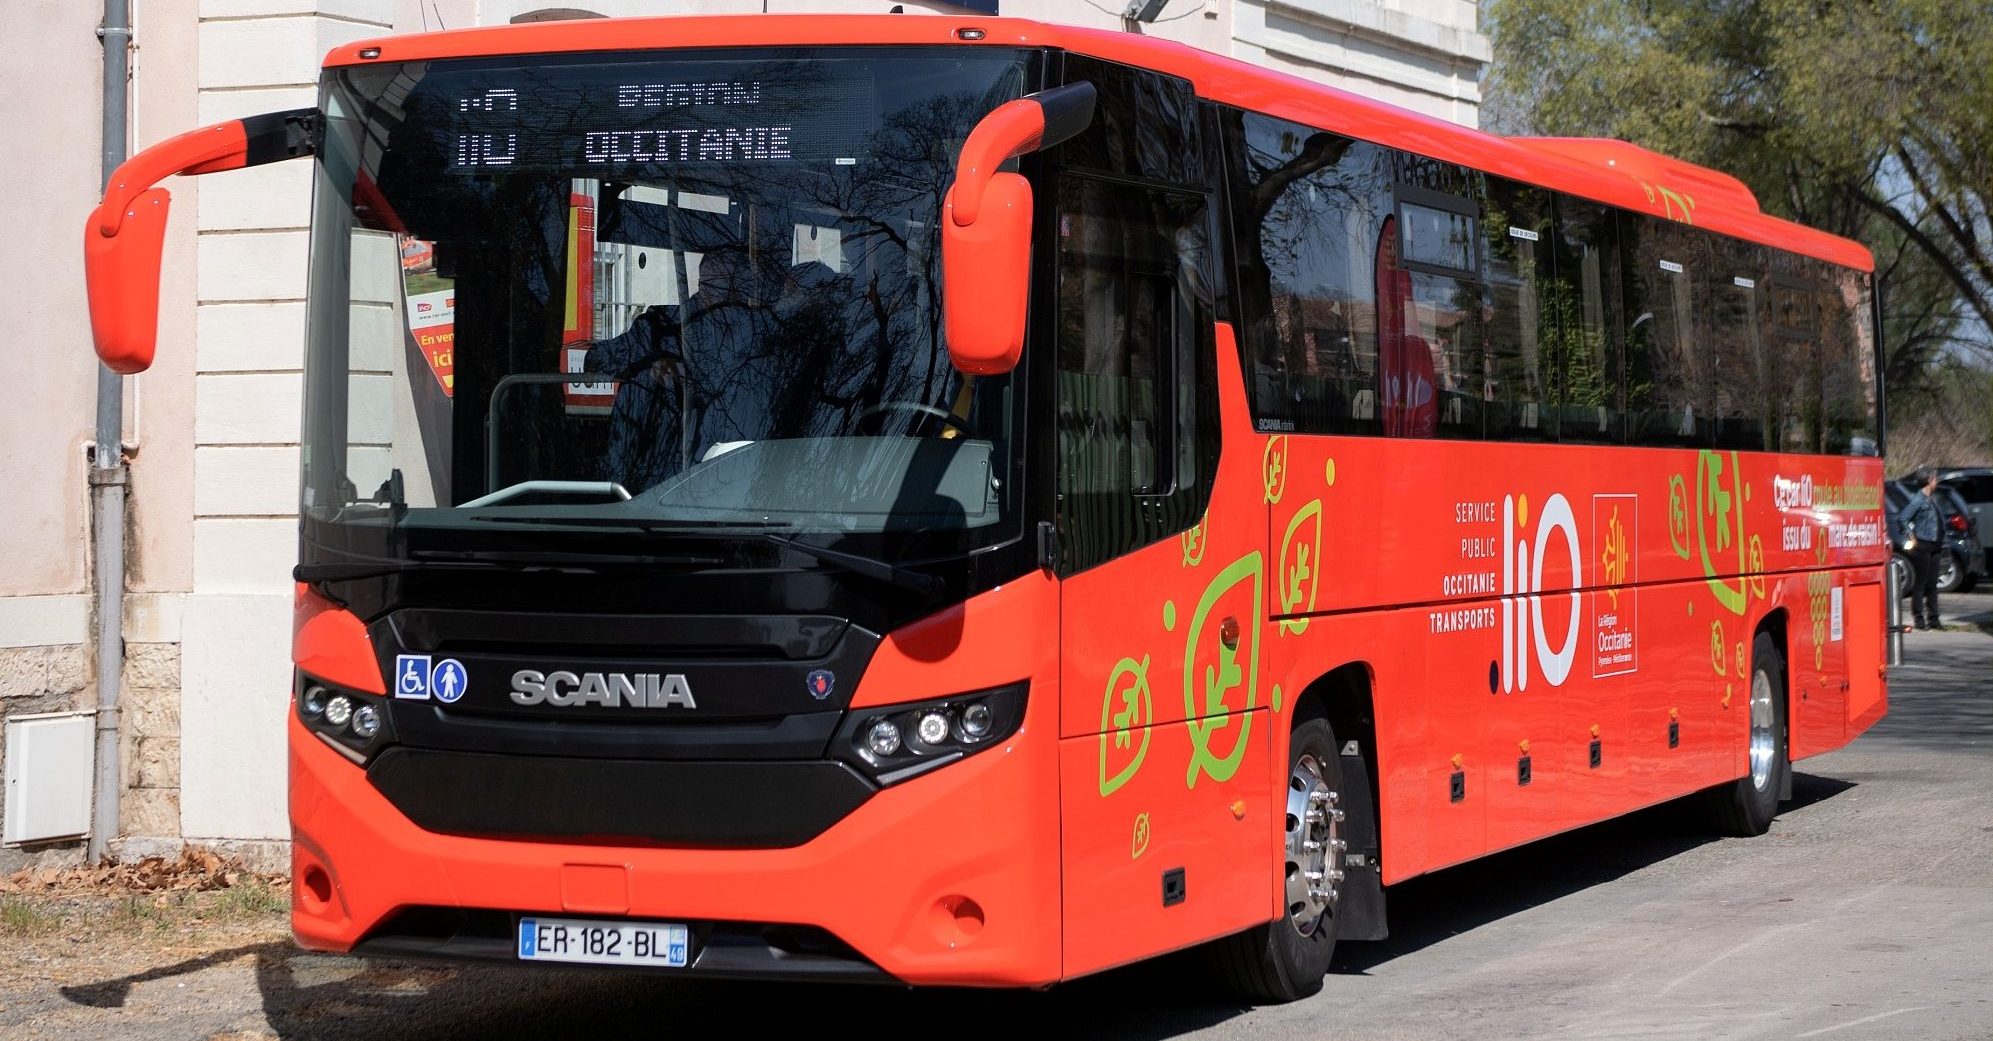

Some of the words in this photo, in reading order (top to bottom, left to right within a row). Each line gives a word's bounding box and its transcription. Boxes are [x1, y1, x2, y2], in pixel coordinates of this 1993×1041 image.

[586, 126, 792, 163] OCCITANIE
[421, 335, 435, 346] En
[432, 349, 453, 368] ici
[1259, 418, 1281, 430] SCANIA
[1455, 502, 1496, 524] SERVICE
[1782, 518, 1799, 552] issu
[1800, 518, 1812, 550] du
[1461, 537, 1496, 559] PUBLIC
[1443, 572, 1496, 597] OCCITANIE
[1429, 607, 1496, 635] TRANSPORTS
[1598, 627, 1632, 652] Occitanie
[510, 669, 697, 709] SCANIA
[537, 925, 667, 958] ER-182-BL
[670, 946, 684, 962] 48
